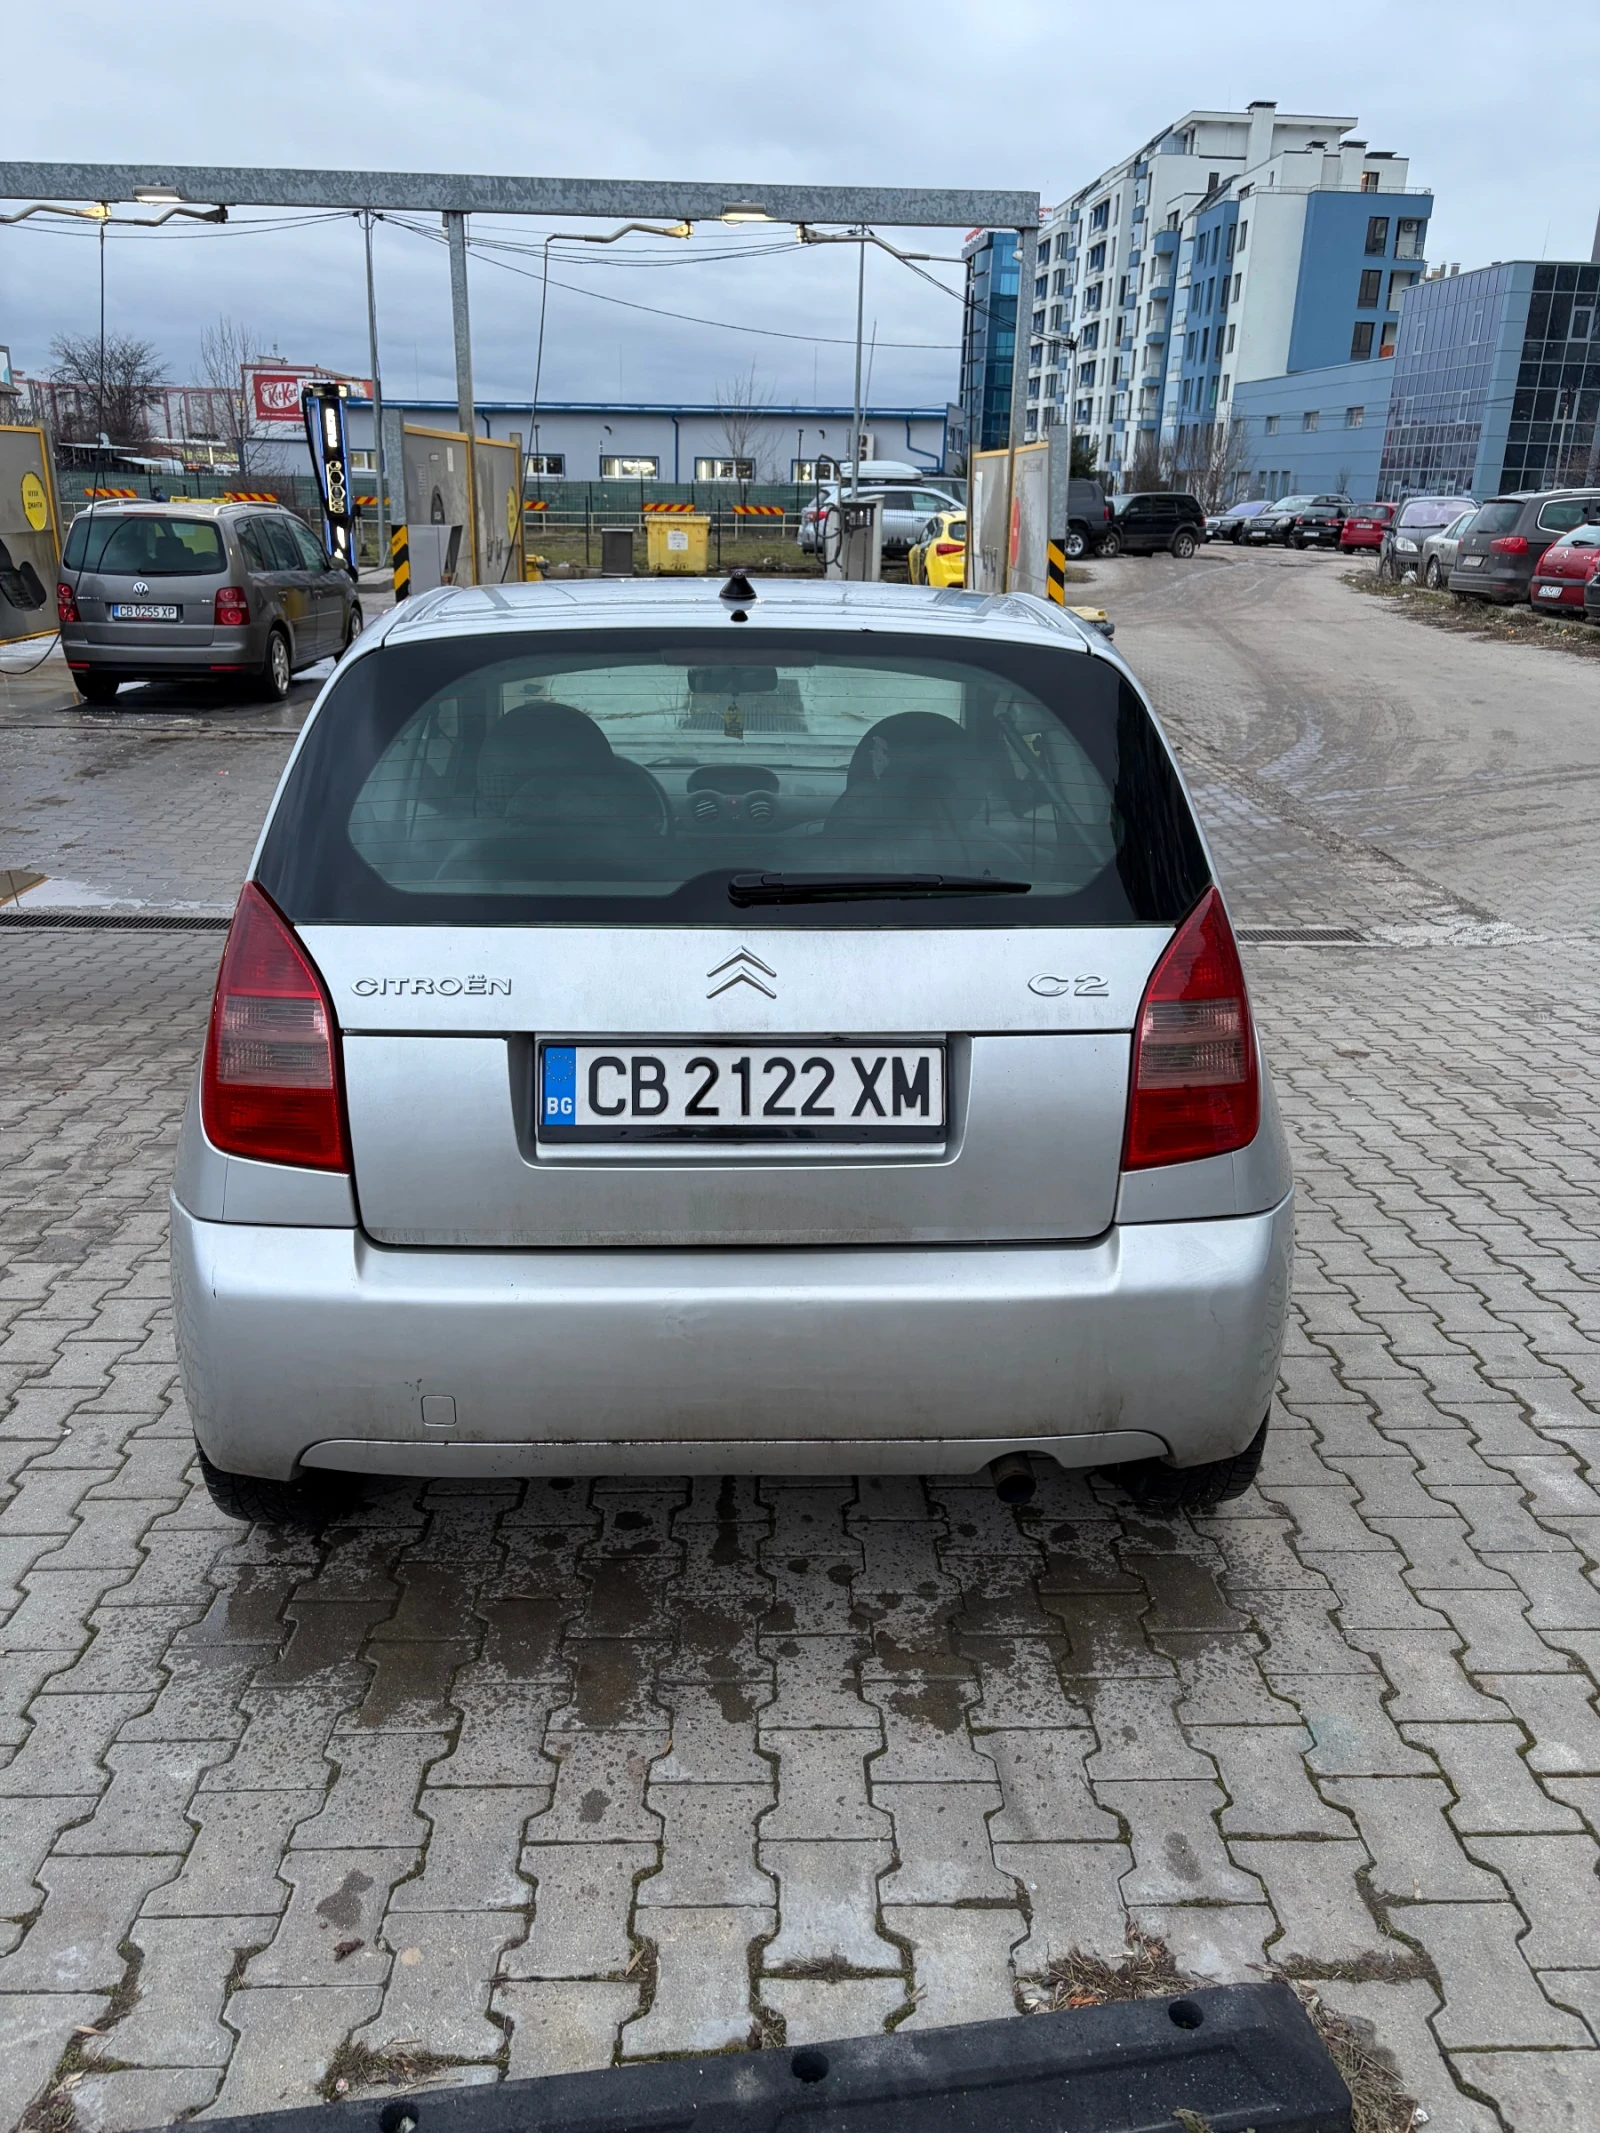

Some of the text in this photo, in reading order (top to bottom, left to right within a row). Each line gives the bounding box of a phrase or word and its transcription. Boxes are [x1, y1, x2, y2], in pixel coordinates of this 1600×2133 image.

[268, 383, 297, 407] KitKat
[120, 605, 175, 618] CB 0255 XP
[350, 974, 512, 997] CITROËN
[1027, 972, 1110, 997] C2
[588, 1056, 931, 1117] CB 2122 XM
[546, 1096, 573, 1116] BG
